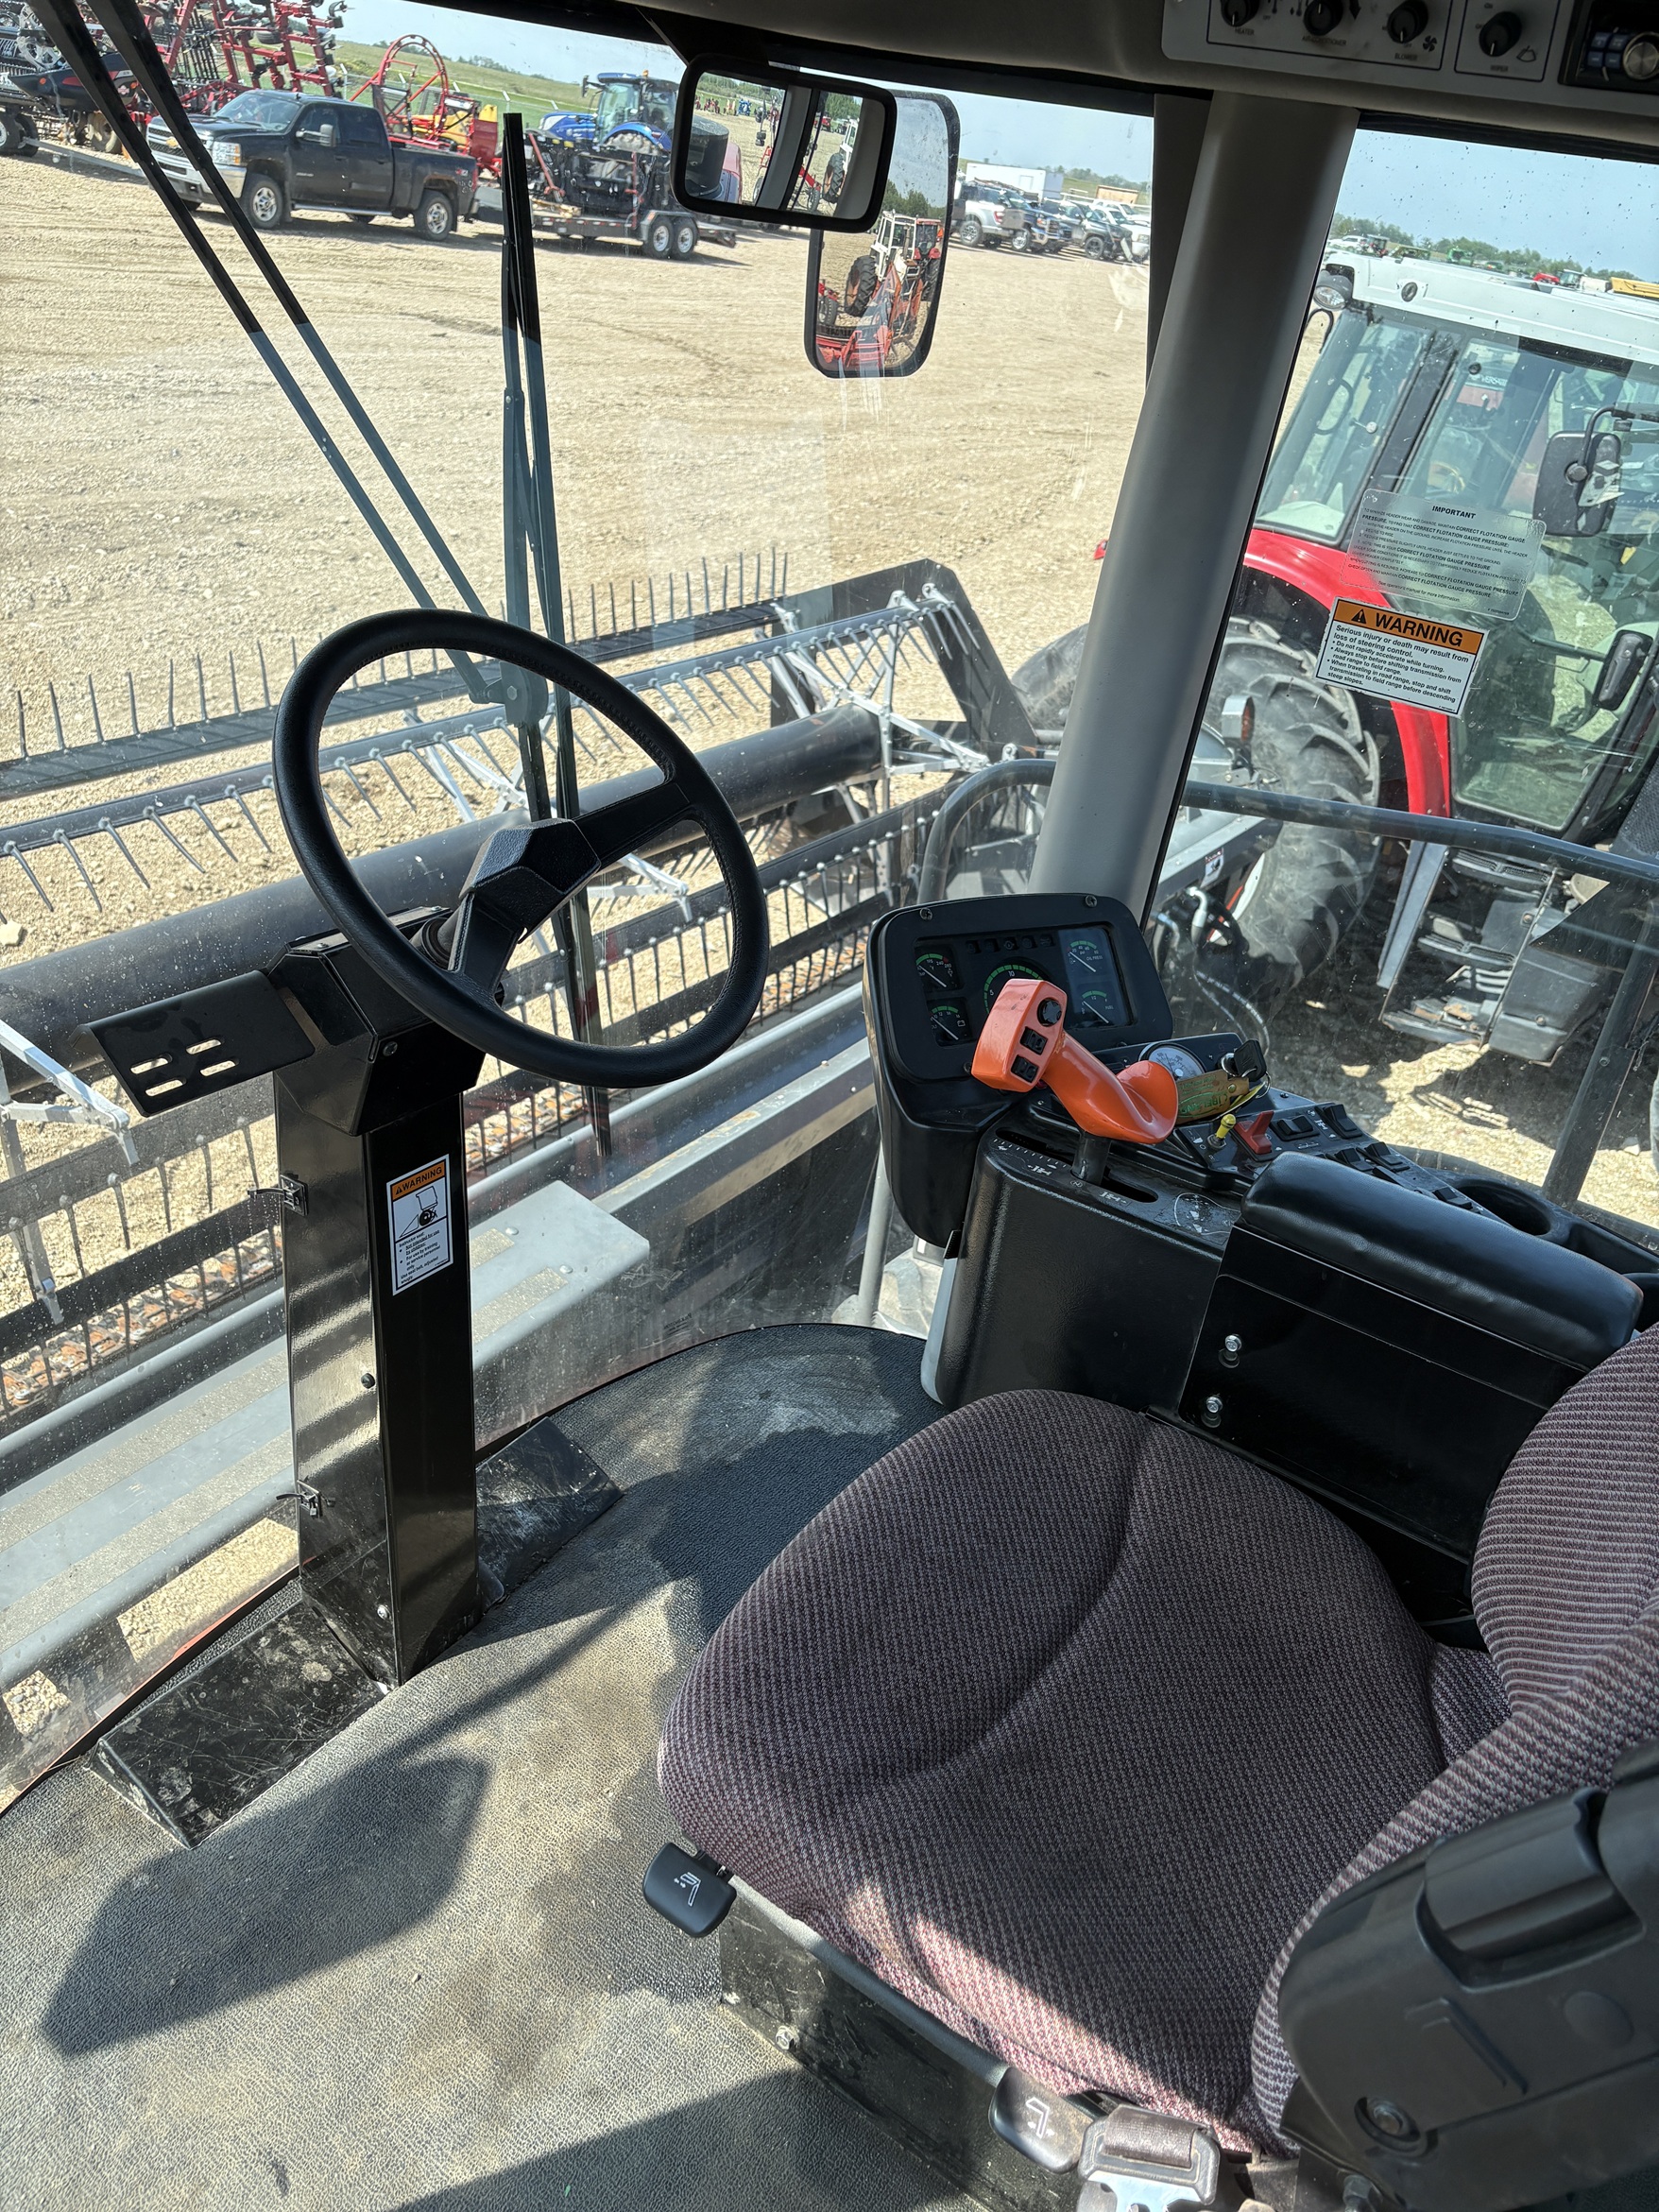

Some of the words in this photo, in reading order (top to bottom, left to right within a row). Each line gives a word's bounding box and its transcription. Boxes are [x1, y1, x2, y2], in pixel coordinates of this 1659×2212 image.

[1234, 27, 1255, 37] HEATER
[1431, 506, 1476, 519] IMPORTANT
[1412, 524, 1435, 533] CORRECT
[1435, 528, 1462, 539] FLOTATION
[1449, 538, 1471, 546] FLOTATION
[1455, 525, 1479, 534] CORRECT
[1479, 530, 1507, 540] FLOTATION
[1507, 535, 1526, 543] GAUGE
[1396, 547, 1419, 556] CORRECT
[1419, 551, 1446, 561] FLOTATION
[1463, 560, 1491, 570] PRESSURE
[1397, 574, 1420, 582] CORRECT
[1420, 578, 1446, 588] FLOTATION
[1464, 588, 1491, 597] PRESSURE
[1446, 577, 1474, 587] FLOTATION
[1492, 587, 1518, 596] PRESSURE
[1376, 612, 1463, 646] WARNING
[1333, 632, 1348, 641] loss
[1357, 638, 1386, 651] steering
[1386, 644, 1414, 657] control.
[1335, 624, 1362, 636] Serious
[1361, 630, 1383, 643] injury
[1392, 638, 1413, 648] death
[1412, 643, 1429, 654] may
[1429, 646, 1451, 658] result
[1451, 651, 1470, 661] from
[1332, 652, 1346, 660] road
[1345, 657, 1363, 665] range
[1382, 666, 1402, 676] range.
[1333, 646, 1355, 657] Always
[1354, 651, 1368, 660] stop
[1367, 655, 1387, 664] before
[1387, 660, 1410, 671] shifting
[1409, 665, 1447, 679] transmission
[1446, 675, 1462, 683] from
[1354, 645, 1376, 656] rapidly
[1375, 650, 1406, 662] accelerate
[1405, 658, 1422, 666] while
[1421, 661, 1445, 673] turning.
[1326, 671, 1343, 679] steep
[1343, 676, 1364, 685] slopes.
[1328, 664, 1365, 678] transmission
[1384, 680, 1402, 689] range
[1402, 684, 1422, 694] before
[1421, 689, 1456, 703] descending
[1330, 659, 1347, 667] When
[1346, 662, 1372, 675] traveling
[1392, 676, 1411, 685] range,
[1411, 679, 1426, 689] stop
[402, 1166, 442, 1191] WARNING
[399, 1235, 416, 1247] Instructor
[423, 1244, 440, 1257] personnel
[424, 1241, 437, 1251] training
[423, 1255, 438, 1267] adjusted
